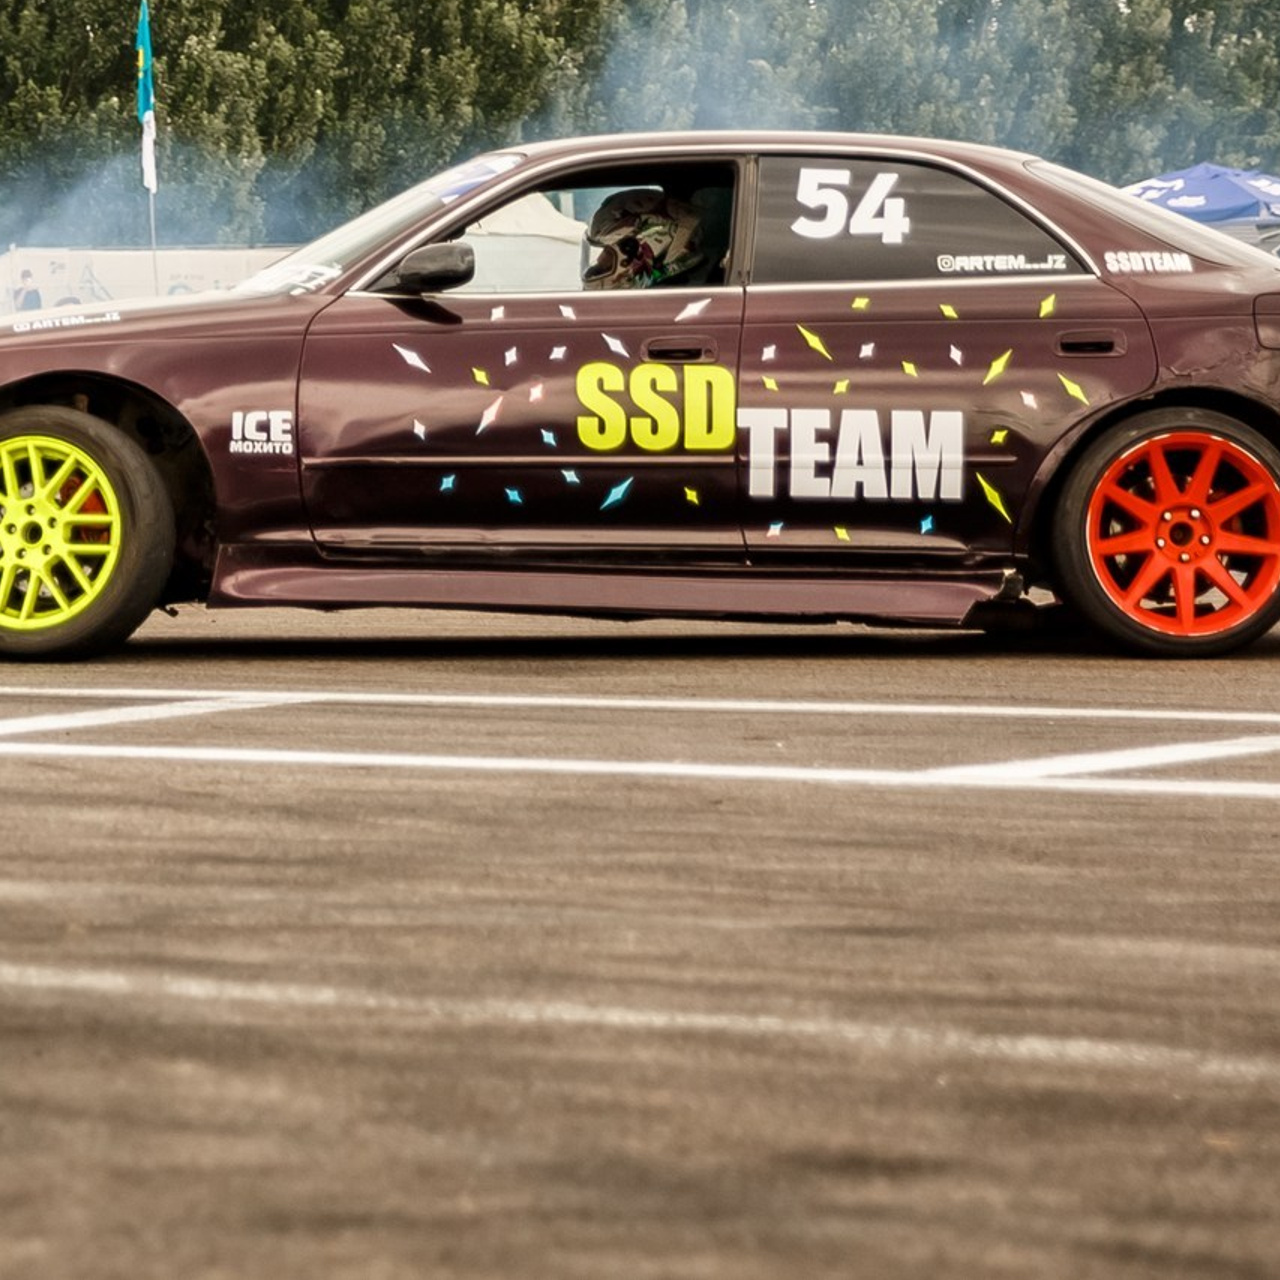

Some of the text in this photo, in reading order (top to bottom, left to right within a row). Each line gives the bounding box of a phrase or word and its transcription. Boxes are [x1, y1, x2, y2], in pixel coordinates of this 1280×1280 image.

[791, 168, 911, 244] 54
[1103, 251, 1193, 273] SSDTEAM
[231, 410, 293, 442] ICE
[575, 362, 736, 451] SSD
[229, 440, 294, 455] МОХИТО
[737, 408, 965, 501] TEAM
